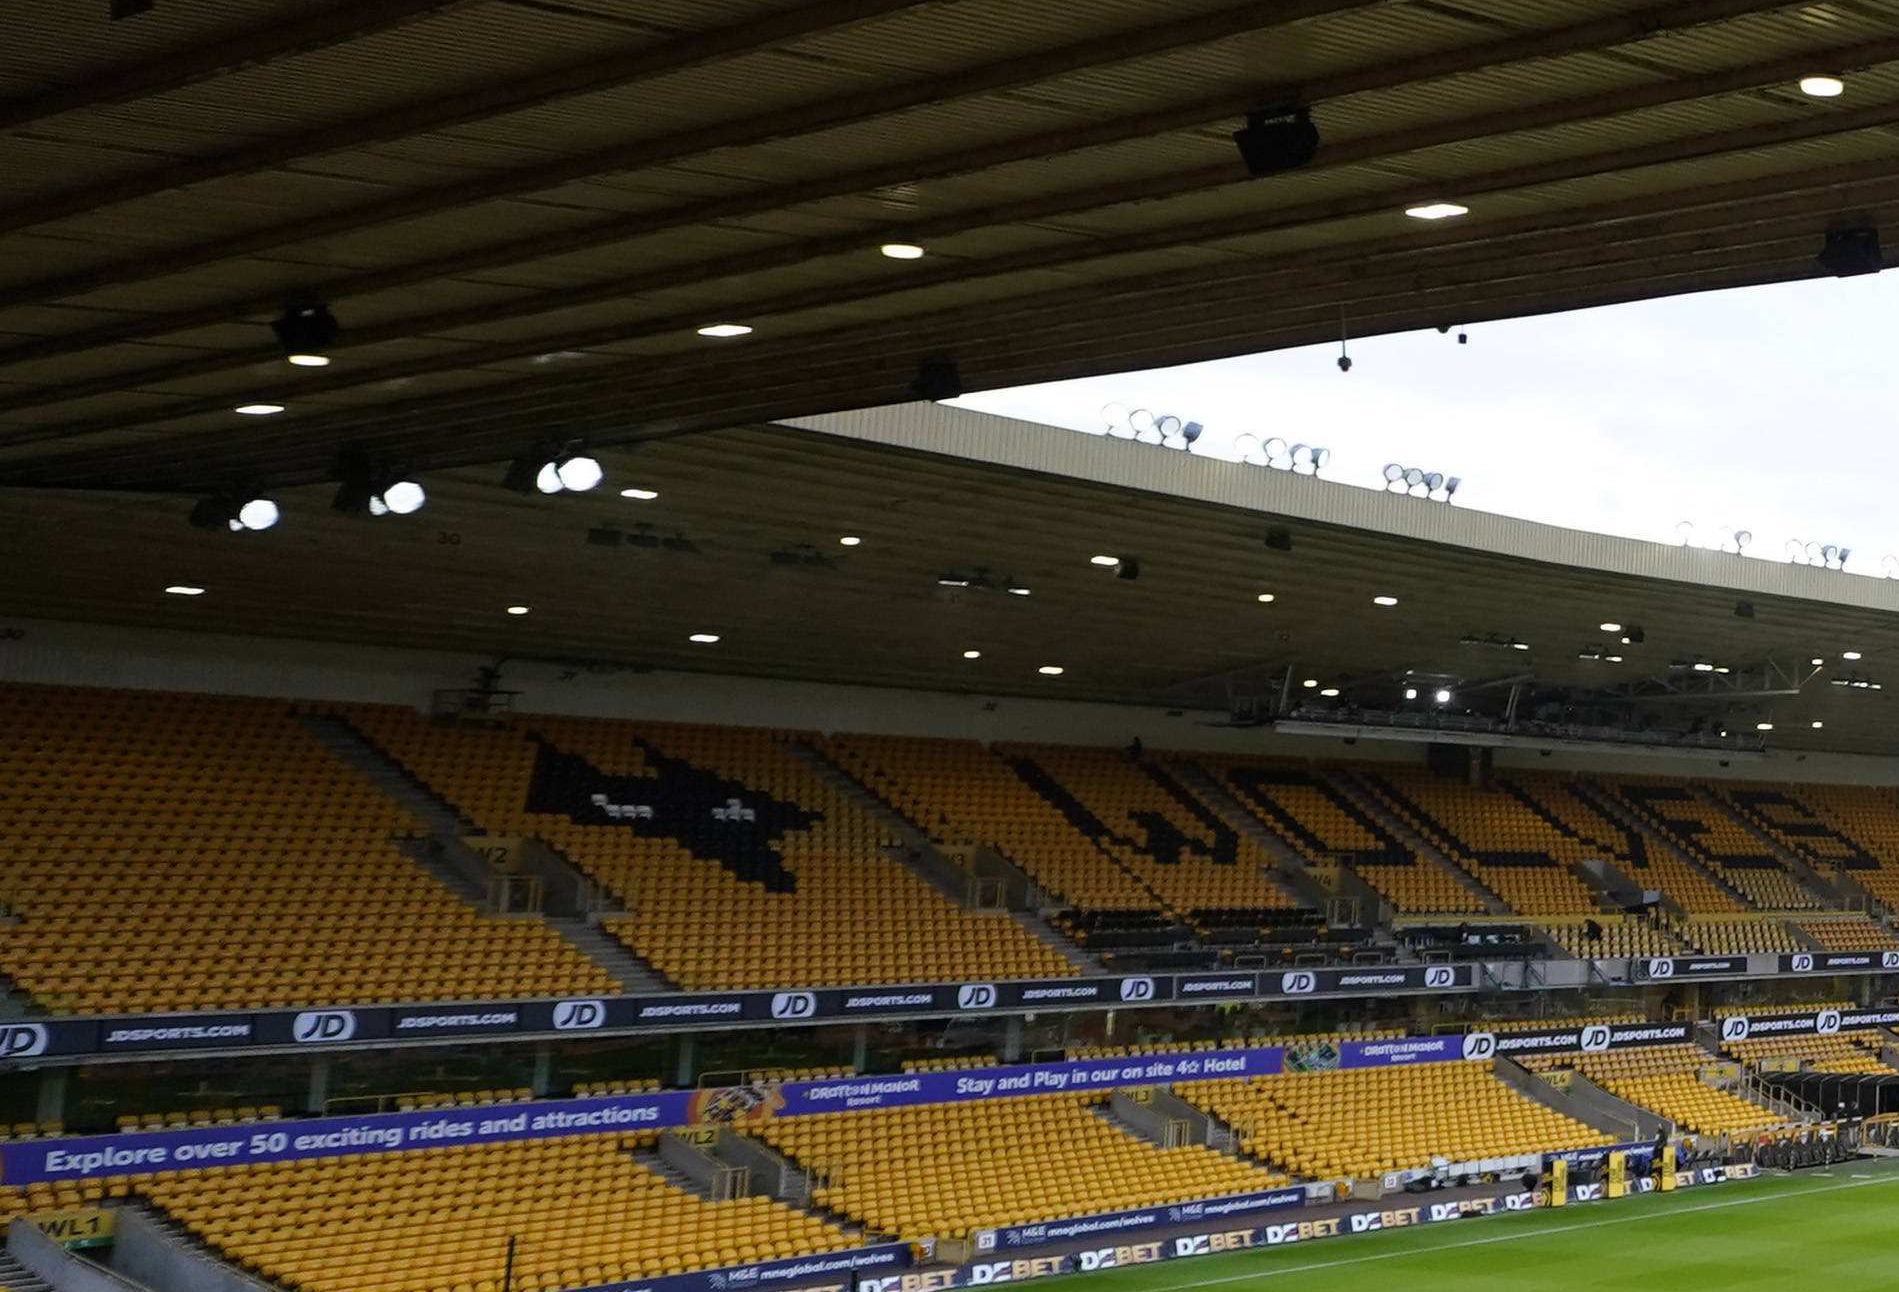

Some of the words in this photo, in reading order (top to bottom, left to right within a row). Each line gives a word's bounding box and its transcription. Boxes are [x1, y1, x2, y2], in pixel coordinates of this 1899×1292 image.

[302, 1014, 347, 1038] JD
[560, 1004, 598, 1027] JD
[779, 995, 809, 1015] JD
[964, 986, 990, 1006] JD
[1126, 979, 1150, 998] JD
[1466, 1038, 1491, 1055] JD
[1496, 1034, 1577, 1050] JDSPORTS.COM
[1584, 1031, 1606, 1048] JD
[1611, 1026, 1685, 1042] JDSPORTS.COM
[1727, 1021, 1744, 1038] JD
[1820, 1014, 1837, 1030] JD
[957, 1076, 993, 1095] Stay
[998, 1073, 1029, 1092] and
[1033, 1070, 1068, 1091] Play
[1073, 1069, 1087, 1084] in
[1091, 1068, 1117, 1082] our
[1122, 1066, 1142, 1079] on
[1145, 1060, 1173, 1077] site
[1204, 1057, 1246, 1073] Hotel
[45, 1145, 166, 1173] Explore
[175, 1140, 242, 1159] over
[250, 1134, 286, 1155] 50
[295, 1125, 401, 1151] exciting
[409, 1118, 472, 1139] rides
[479, 1115, 527, 1134] and
[532, 1105, 658, 1130] attractions
[38, 1218, 99, 1237] WL1
[728, 1267, 757, 1281] M&E
